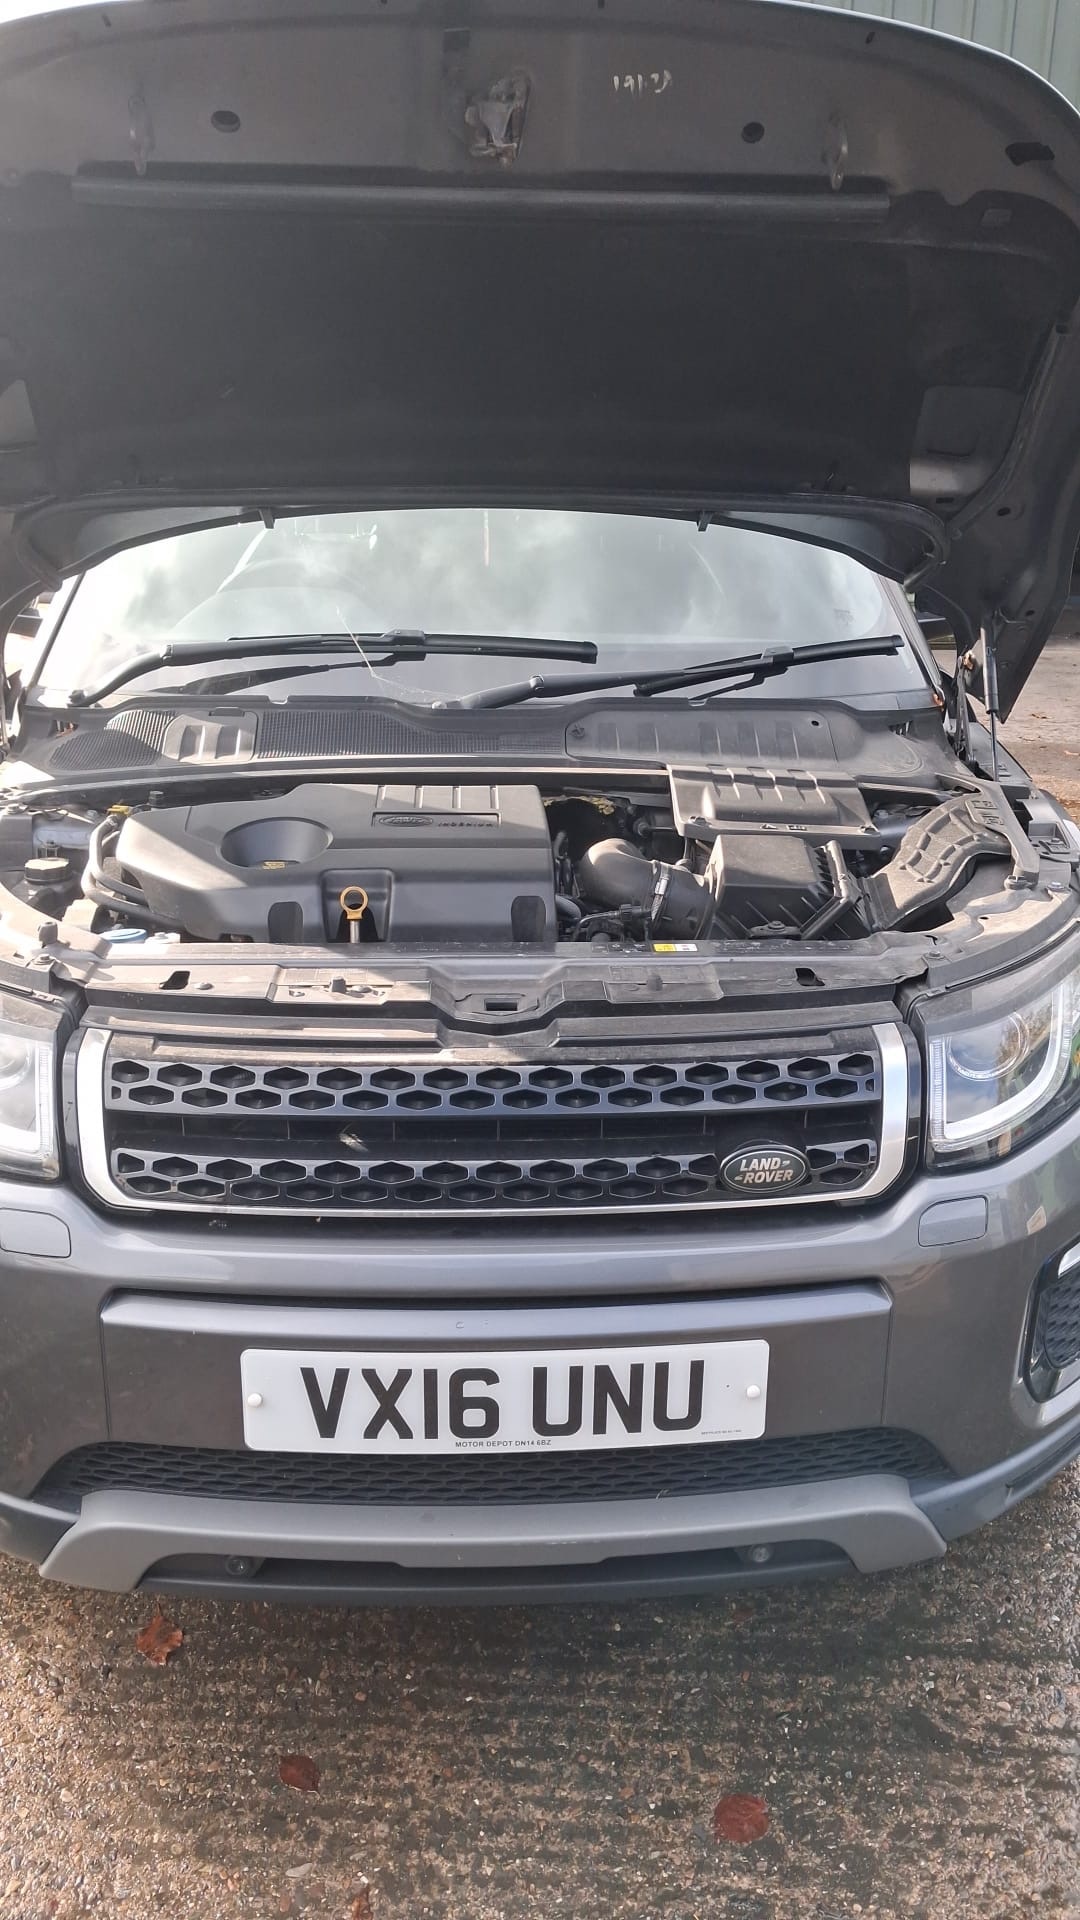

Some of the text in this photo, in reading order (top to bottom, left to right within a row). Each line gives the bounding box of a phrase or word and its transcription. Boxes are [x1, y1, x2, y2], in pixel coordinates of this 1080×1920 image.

[740, 1157, 781, 1171] LAND
[743, 1169, 794, 1184] ROVER
[300, 1360, 704, 1439] VX16 UNU
